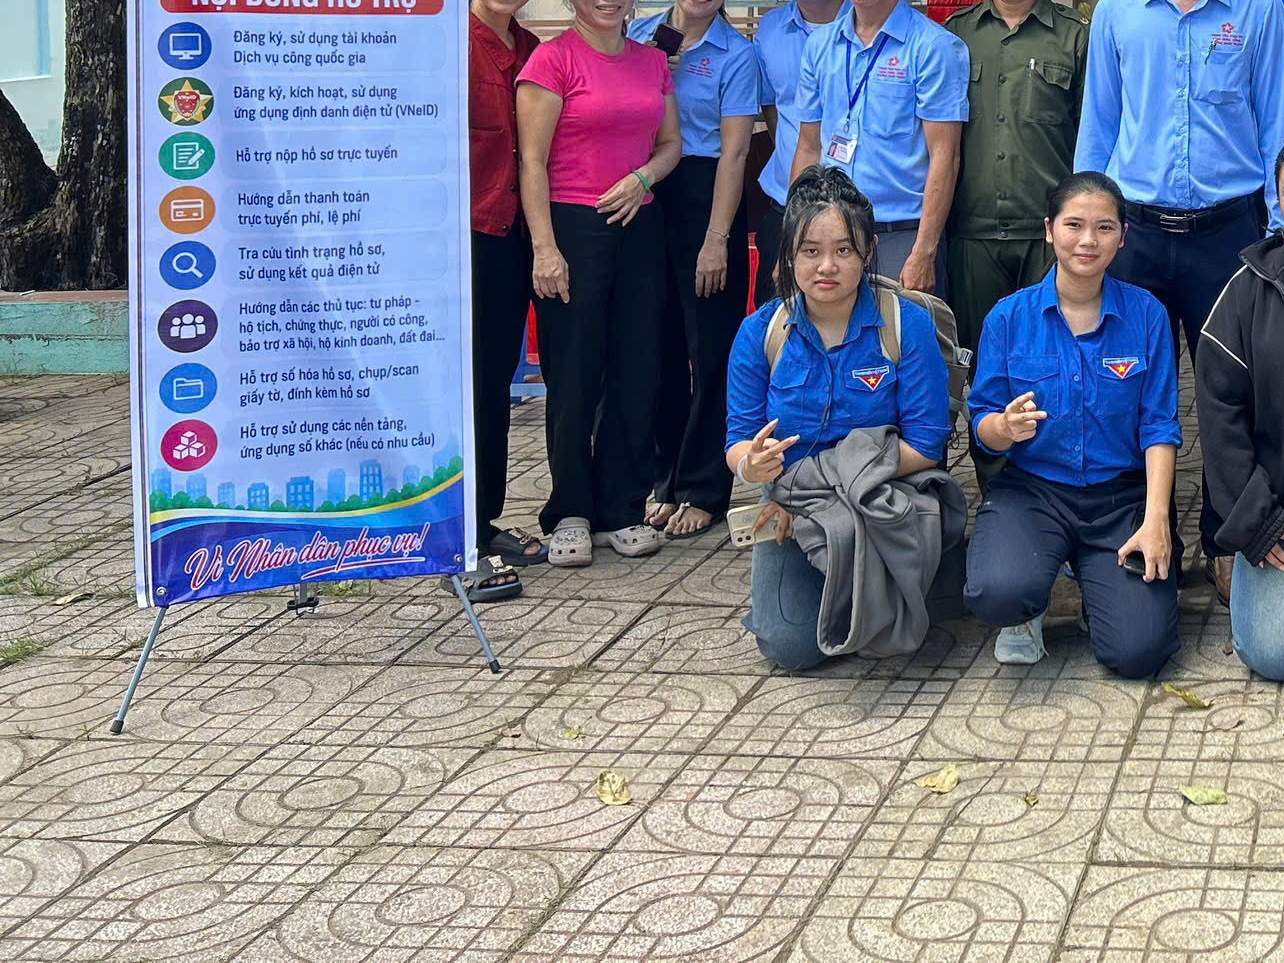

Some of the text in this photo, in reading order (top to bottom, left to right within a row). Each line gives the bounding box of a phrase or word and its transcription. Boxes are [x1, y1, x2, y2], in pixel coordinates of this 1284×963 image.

[234, 31, 396, 47] Đăng ký, sử dụng tài khoản
[234, 49, 365, 66] Dịch vụ công quốc gia
[234, 104, 438, 121] ứng dụng định danh điện tử (VNeID)
[237, 145, 397, 164] Hỗ trợ nộp hồ sơ trực tuyến
[238, 190, 369, 208] Hướng dẫn thanh toán
[238, 241, 385, 260] Tra cứu tình trạng hồ sơ,
[184, 523, 430, 591] Vì Nhân dân phục vụ!
